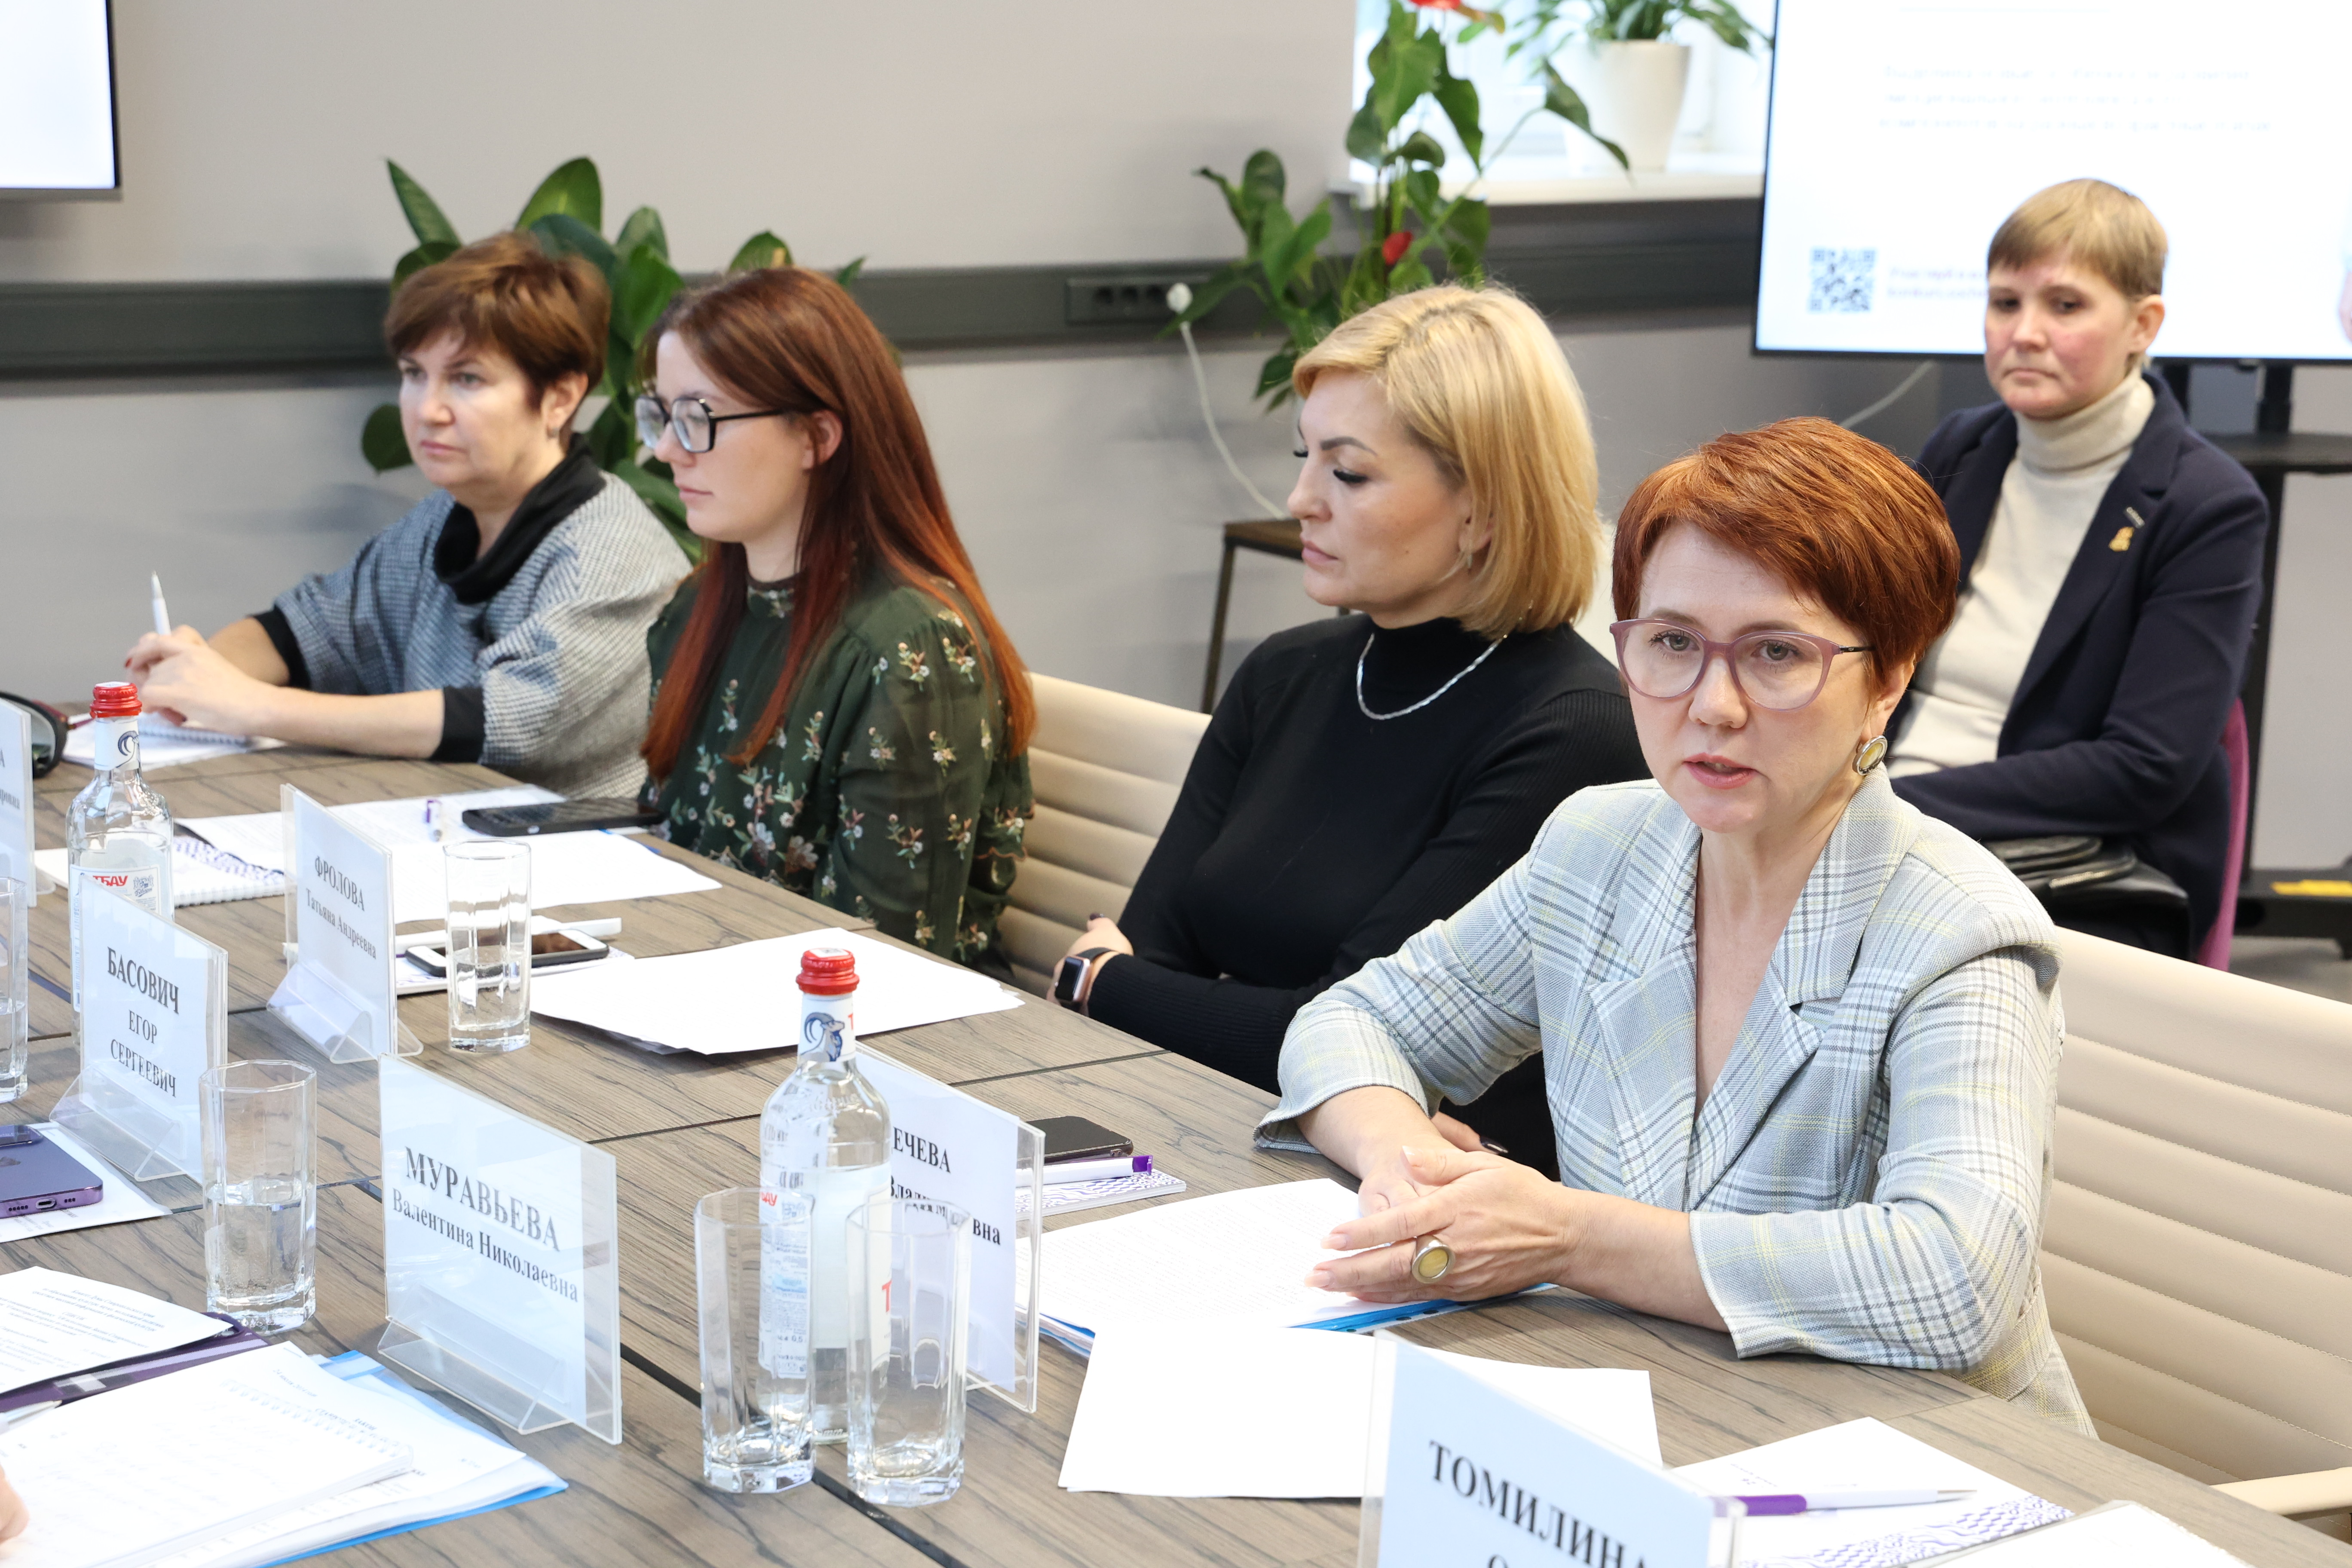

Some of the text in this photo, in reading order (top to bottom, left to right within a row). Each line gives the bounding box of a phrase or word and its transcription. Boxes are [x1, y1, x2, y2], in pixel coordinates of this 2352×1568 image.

[315, 855, 365, 912] ФРОЛОВА
[305, 888, 377, 960] Татьяна Андреевна
[107, 946, 179, 1015] БАСОВИЧ
[129, 1009, 157, 1045] ЕГОР
[111, 1039, 176, 1098] СЕРГЕЕВИЧ
[891, 1127, 951, 1173] ЕЧЕВА
[405, 1146, 560, 1253] МУРАВЬЕВА
[392, 1188, 578, 1303] Валентина Николаевна
